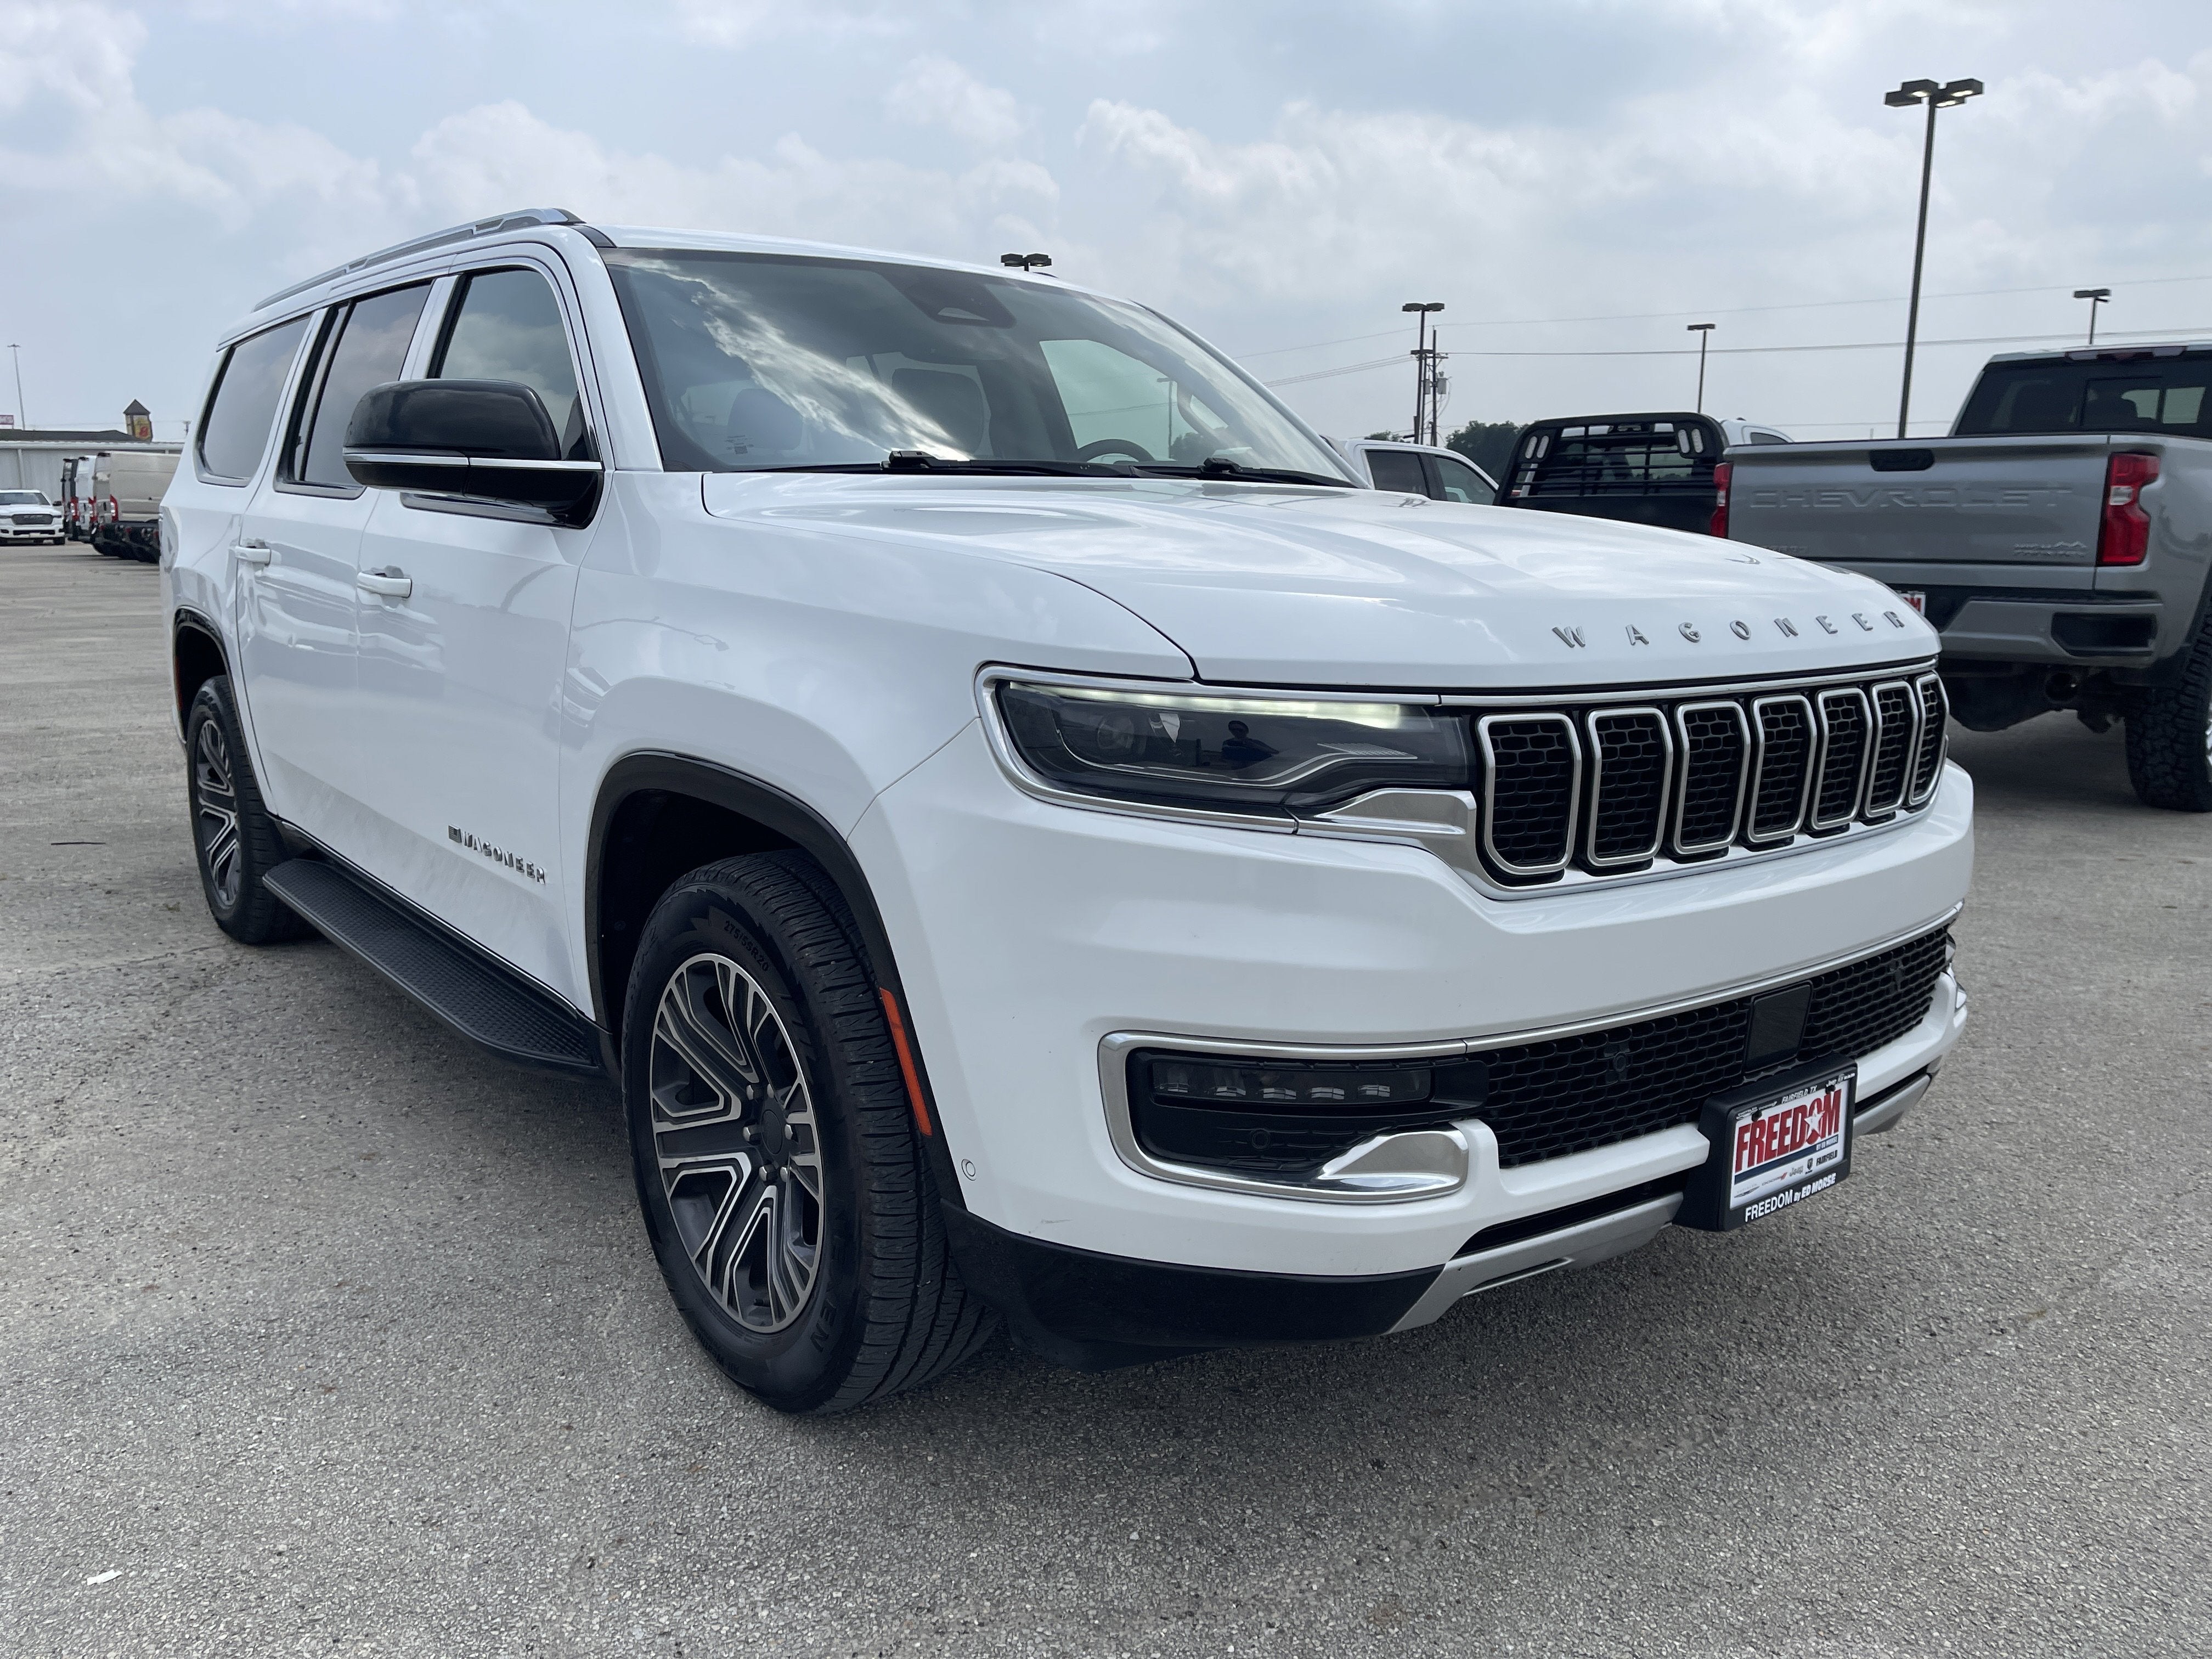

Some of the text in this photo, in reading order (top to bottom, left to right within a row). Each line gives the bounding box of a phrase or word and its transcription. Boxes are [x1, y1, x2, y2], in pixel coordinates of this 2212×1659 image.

[1750, 486, 2073, 508] CHEVROLET
[1552, 610, 1905, 648] WAGONEER
[462, 830, 546, 885] WAGONEER
[1809, 1085, 1818, 1093] TX
[1735, 1088, 1842, 1173] FREEDOM
[1745, 1188, 1793, 1222] FREEDOM
[1801, 1184, 1812, 1199] ED
[1812, 1172, 1837, 1194] MORSE
